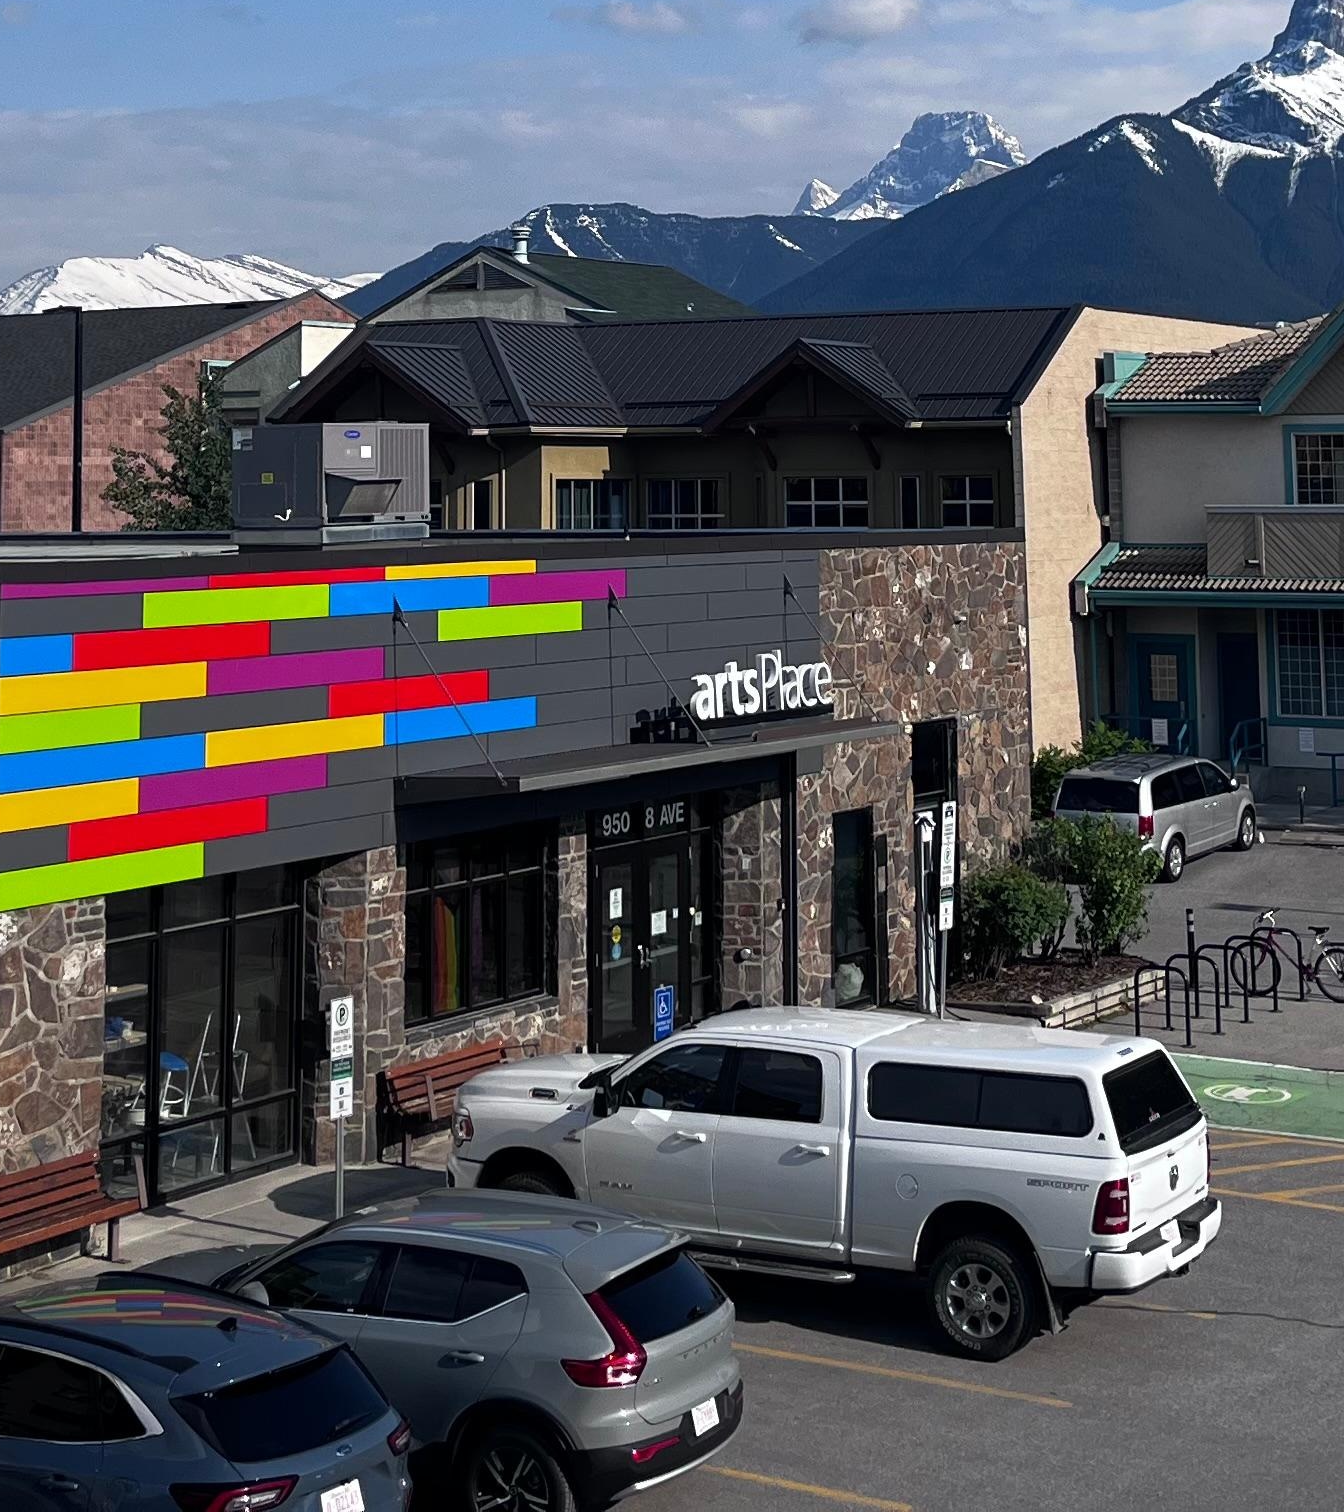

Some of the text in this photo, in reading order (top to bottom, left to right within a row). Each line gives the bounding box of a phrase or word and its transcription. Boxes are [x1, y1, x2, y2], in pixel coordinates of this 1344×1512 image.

[691, 649, 833, 720] artsPlace
[602, 801, 684, 836] 950 8 AVE
[1027, 1178, 1089, 1192] SPORT
